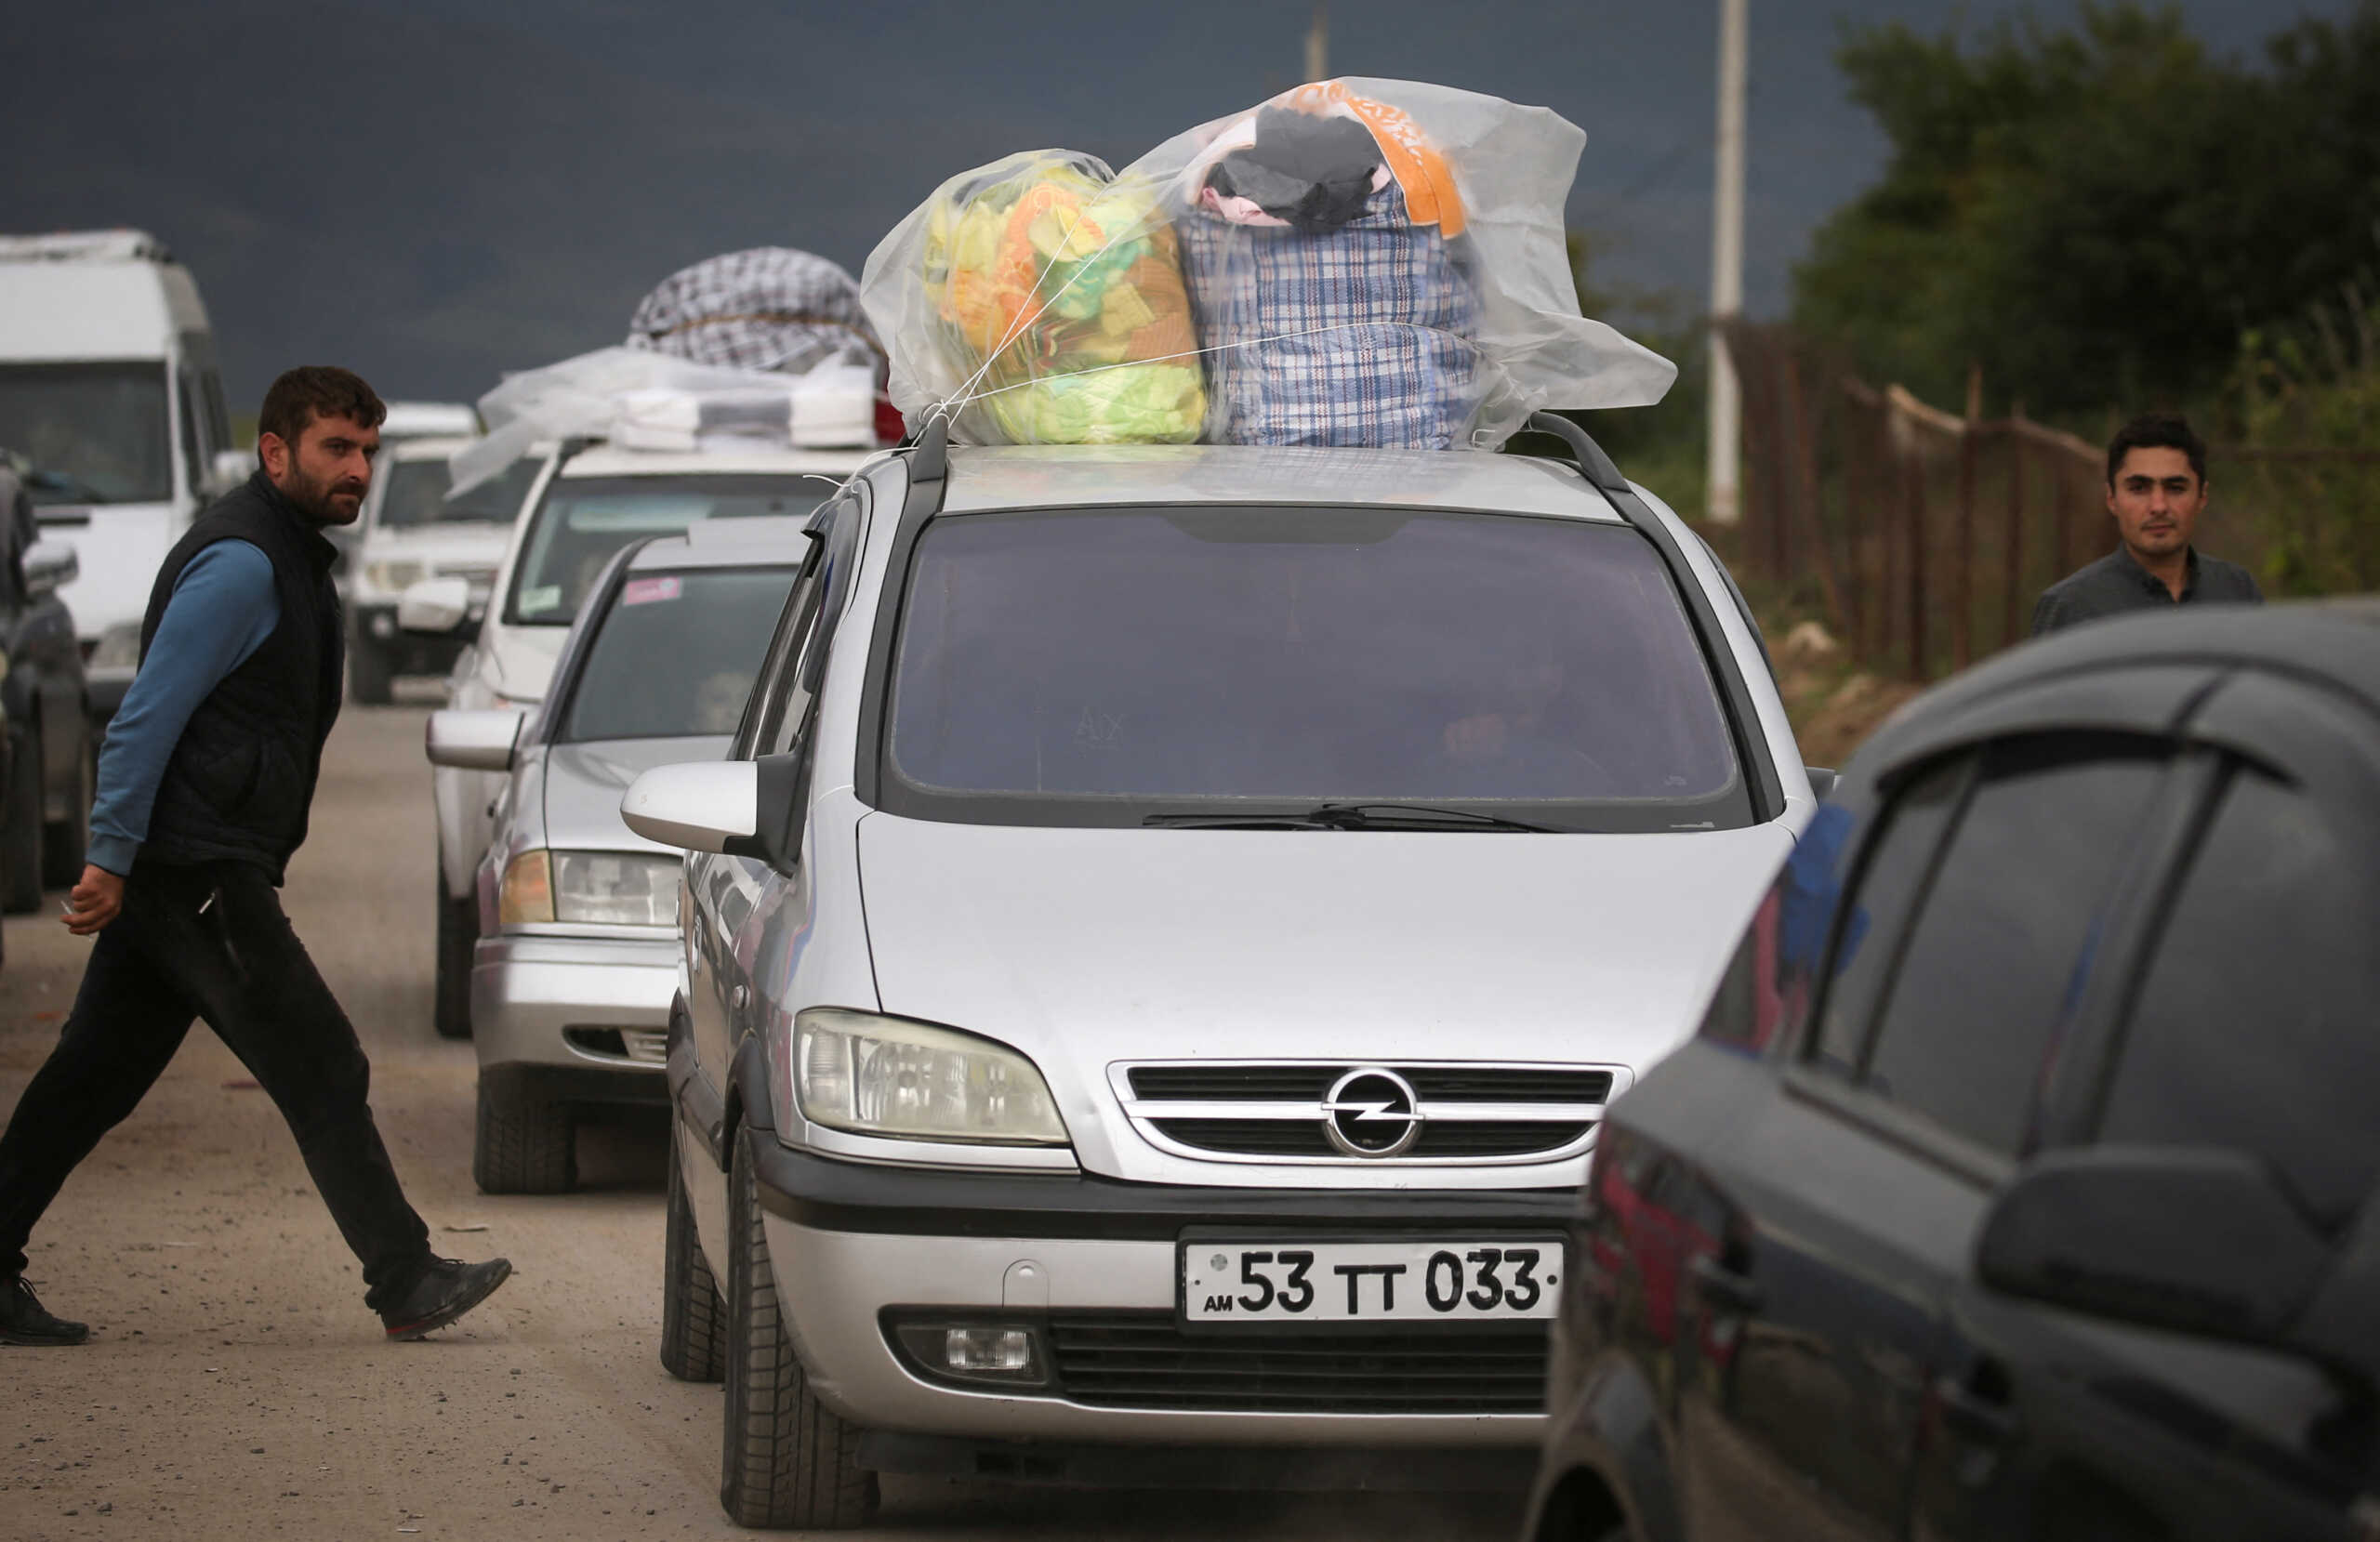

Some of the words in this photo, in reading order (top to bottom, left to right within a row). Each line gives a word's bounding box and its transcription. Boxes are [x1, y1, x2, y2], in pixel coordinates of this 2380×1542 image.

[1204, 1296, 1233, 1311] AM
[1238, 1250, 1315, 1312] 53
[1333, 1263, 1408, 1314] TT
[1425, 1248, 1540, 1312] 033
